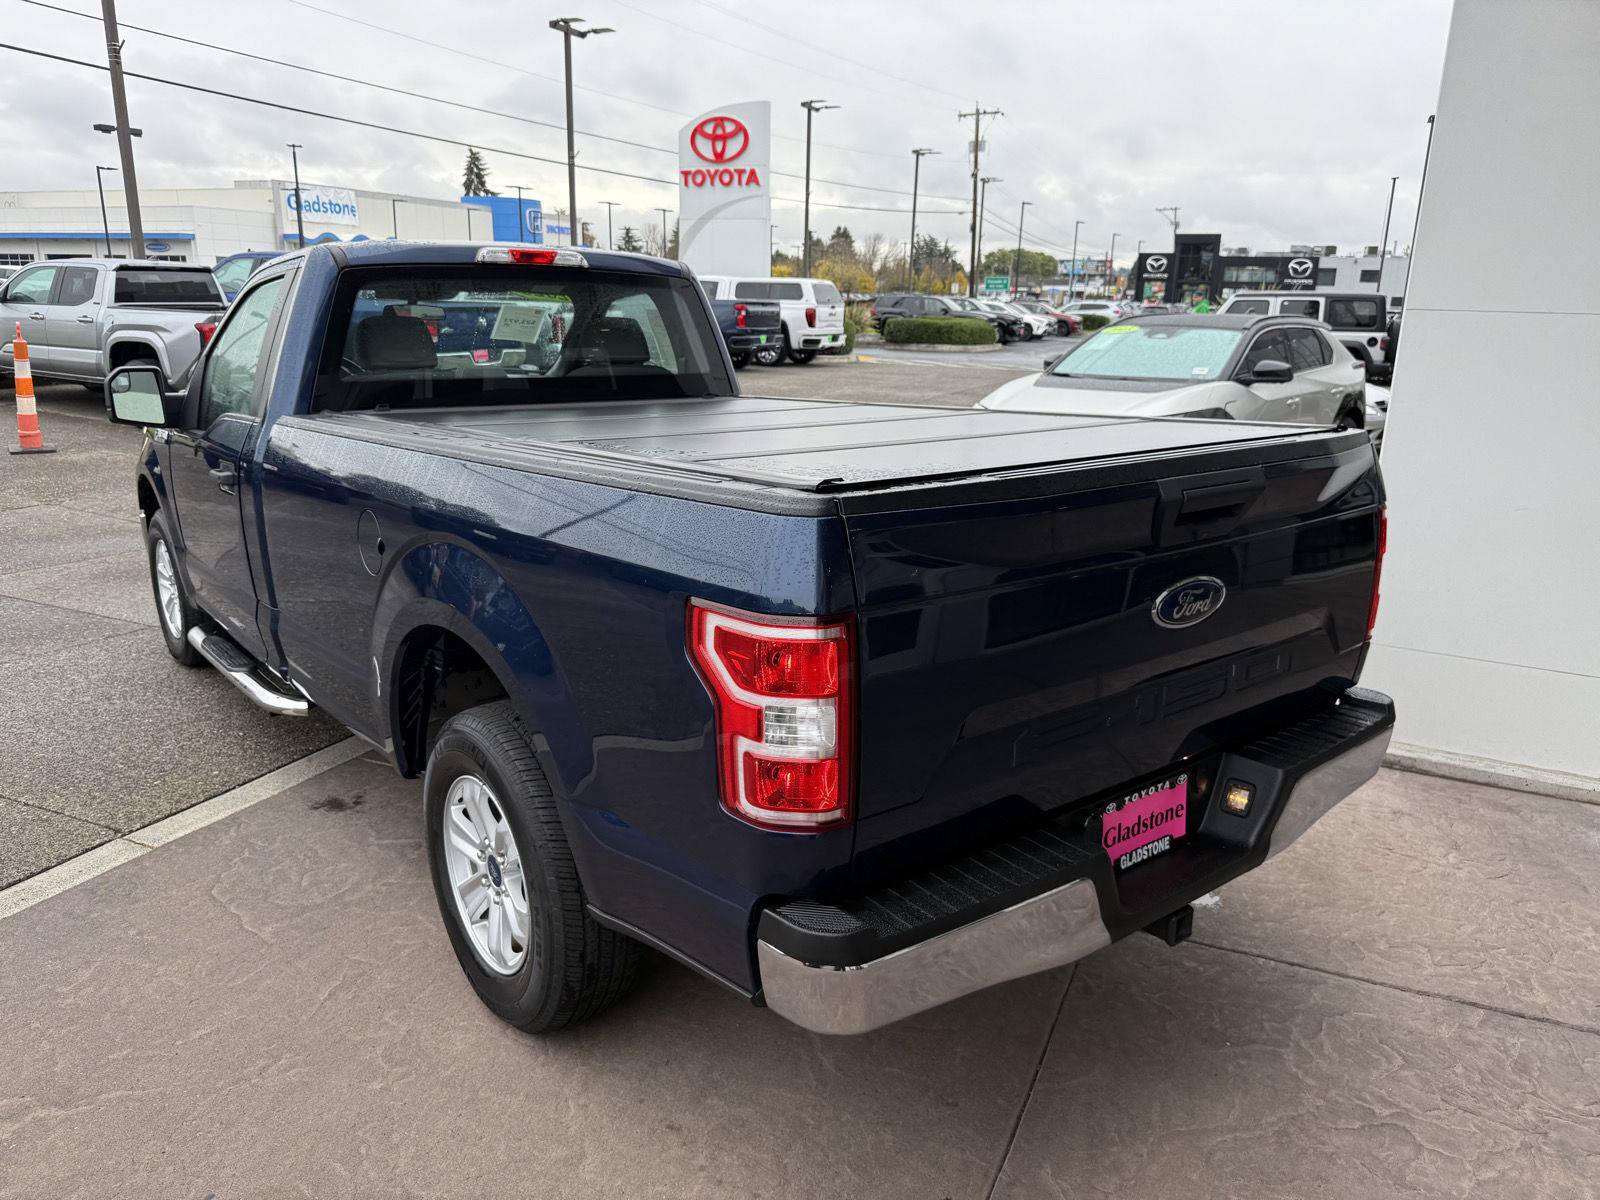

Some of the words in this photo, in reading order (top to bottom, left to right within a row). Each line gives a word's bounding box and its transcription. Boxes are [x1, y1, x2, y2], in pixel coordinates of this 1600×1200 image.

[681, 168, 760, 188] TOYOTA
[287, 193, 357, 217] Gadstone
[1172, 587, 1213, 620] Ford
[1123, 780, 1170, 805] TOYOTA
[1103, 802, 1184, 848] Gladstone
[1120, 836, 1171, 869] GLADSTONE
